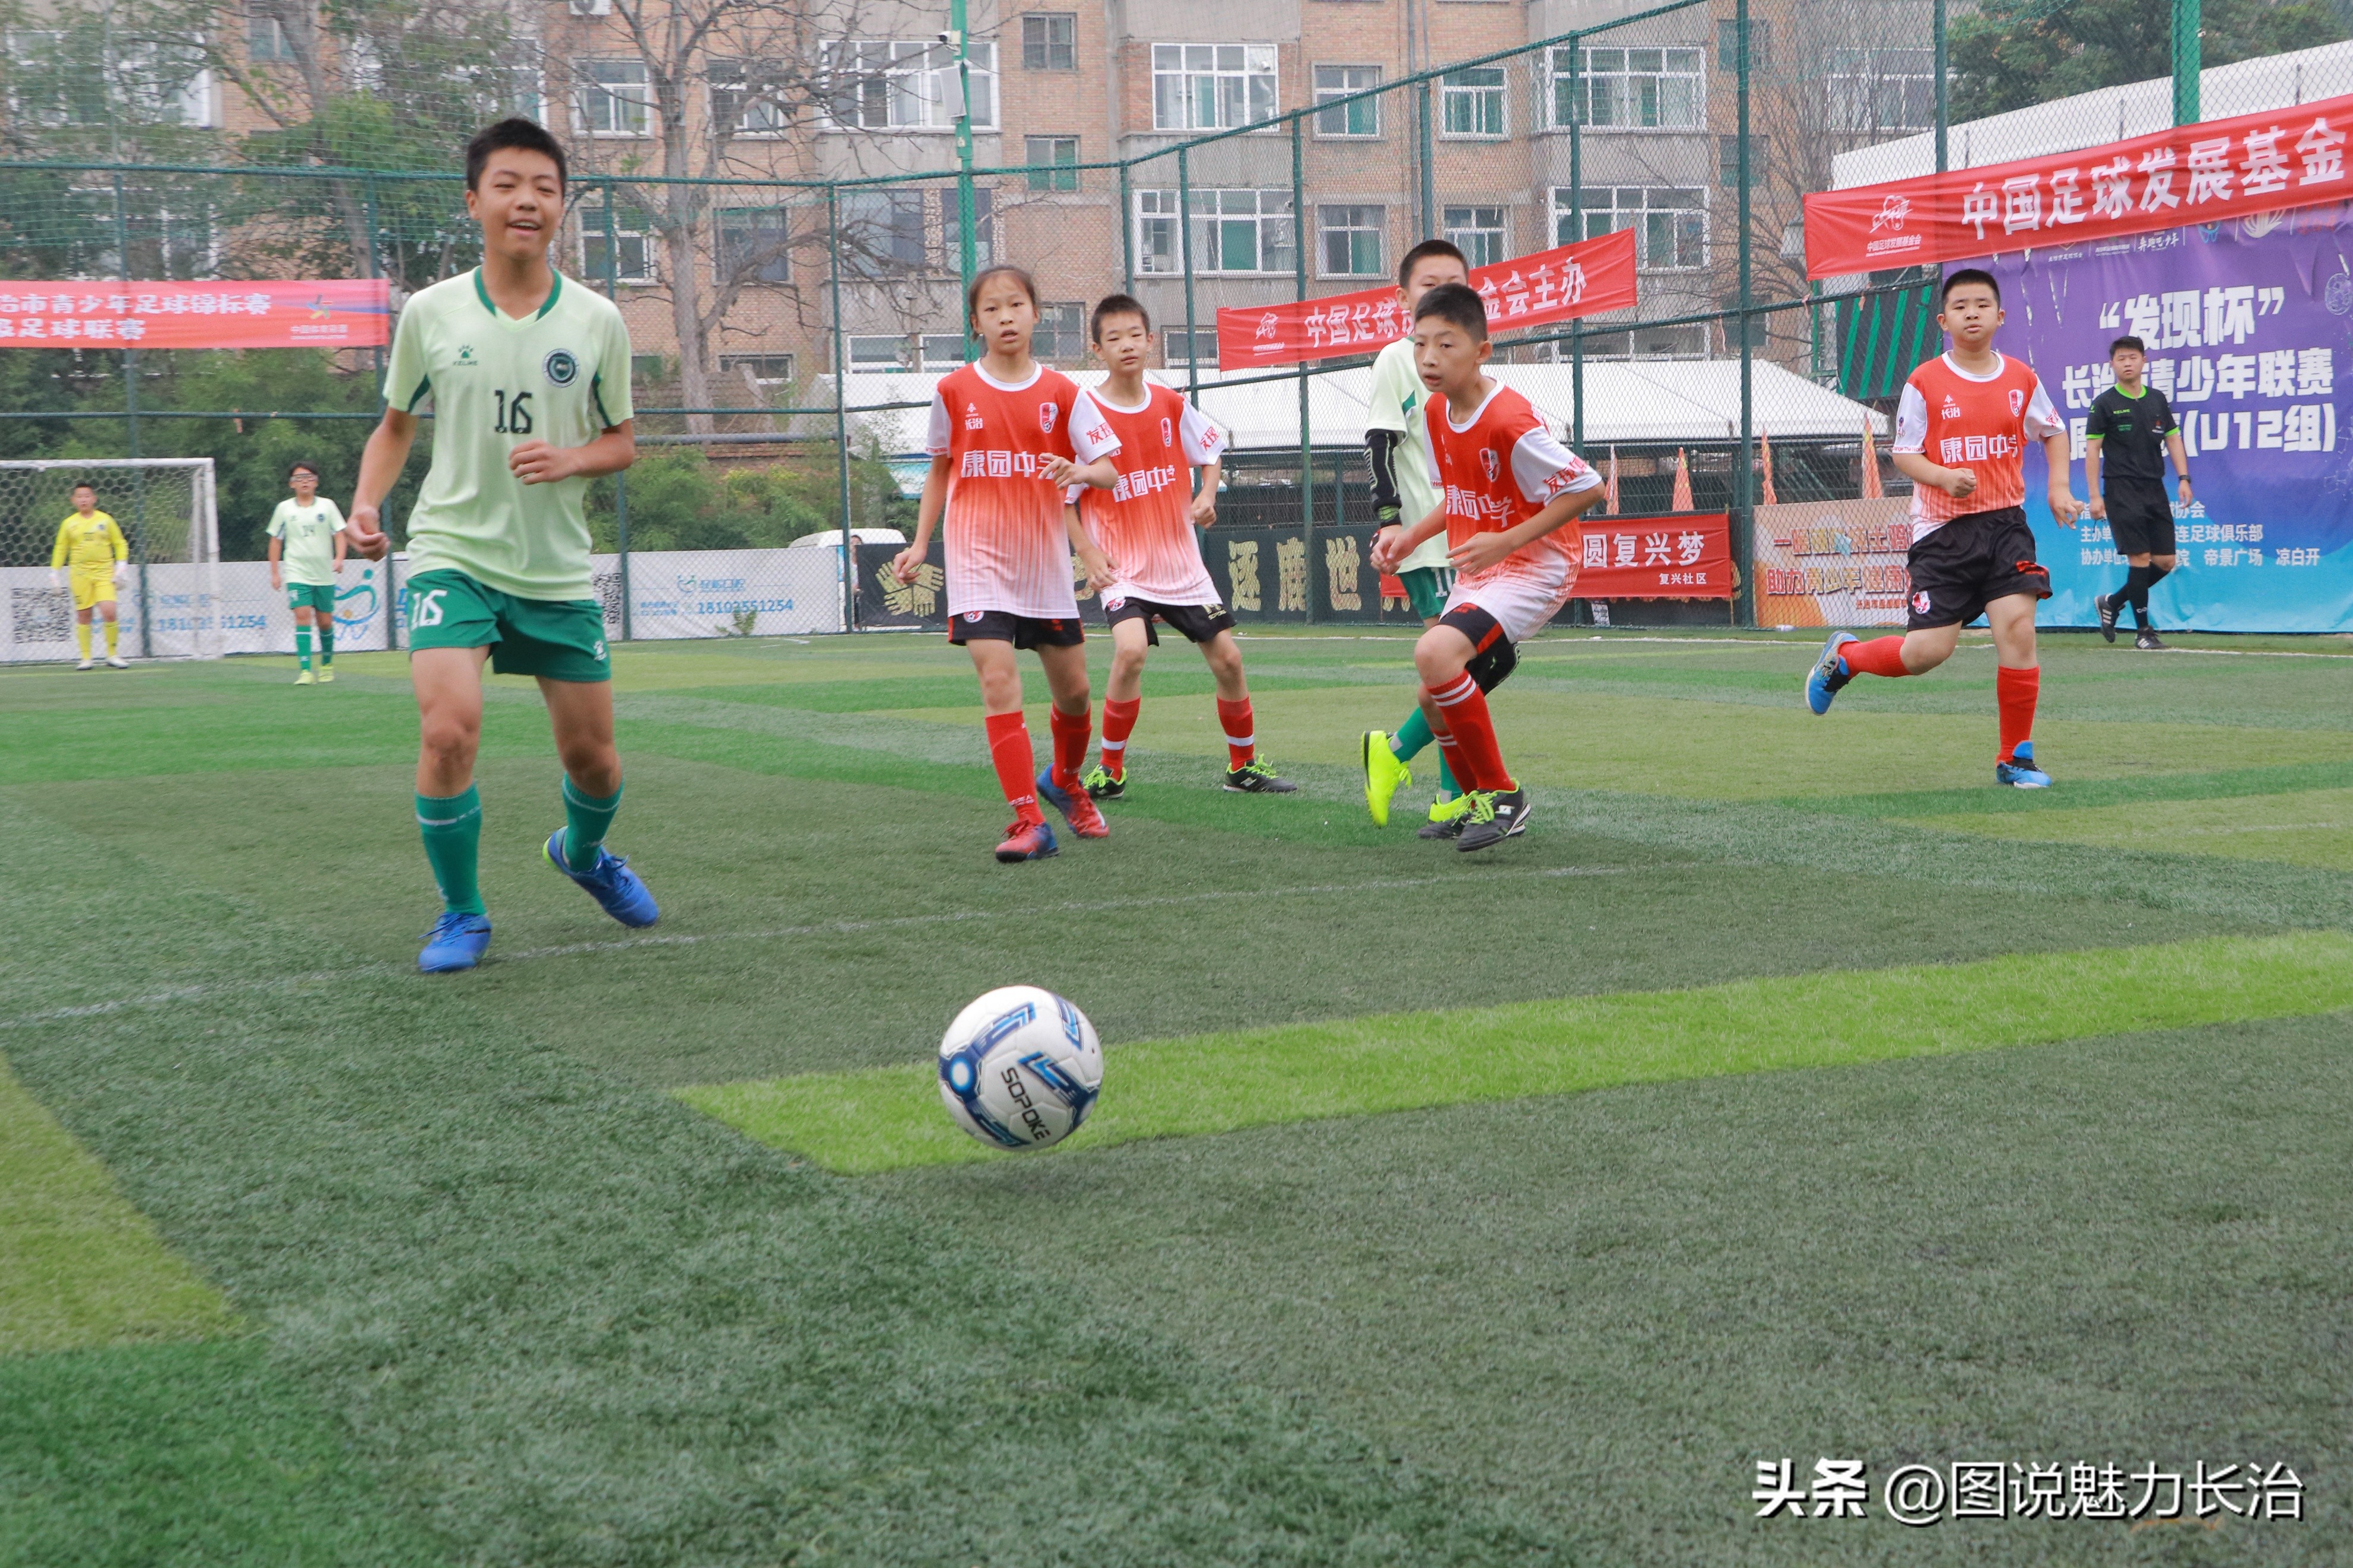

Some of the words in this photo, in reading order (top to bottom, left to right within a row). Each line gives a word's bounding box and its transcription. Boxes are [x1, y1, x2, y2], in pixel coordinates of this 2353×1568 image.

[1961, 117, 2346, 240] 中国足球发展基金
[494, 389, 532, 434] 16
[1583, 531, 1704, 568] 圆复兴梦
[2204, 548, 2263, 566] 帝景广场
[2276, 547, 2320, 566] 凉白开
[1659, 573, 1707, 585] 复兴社区
[1001, 1067, 1051, 1140] SOPOKE
